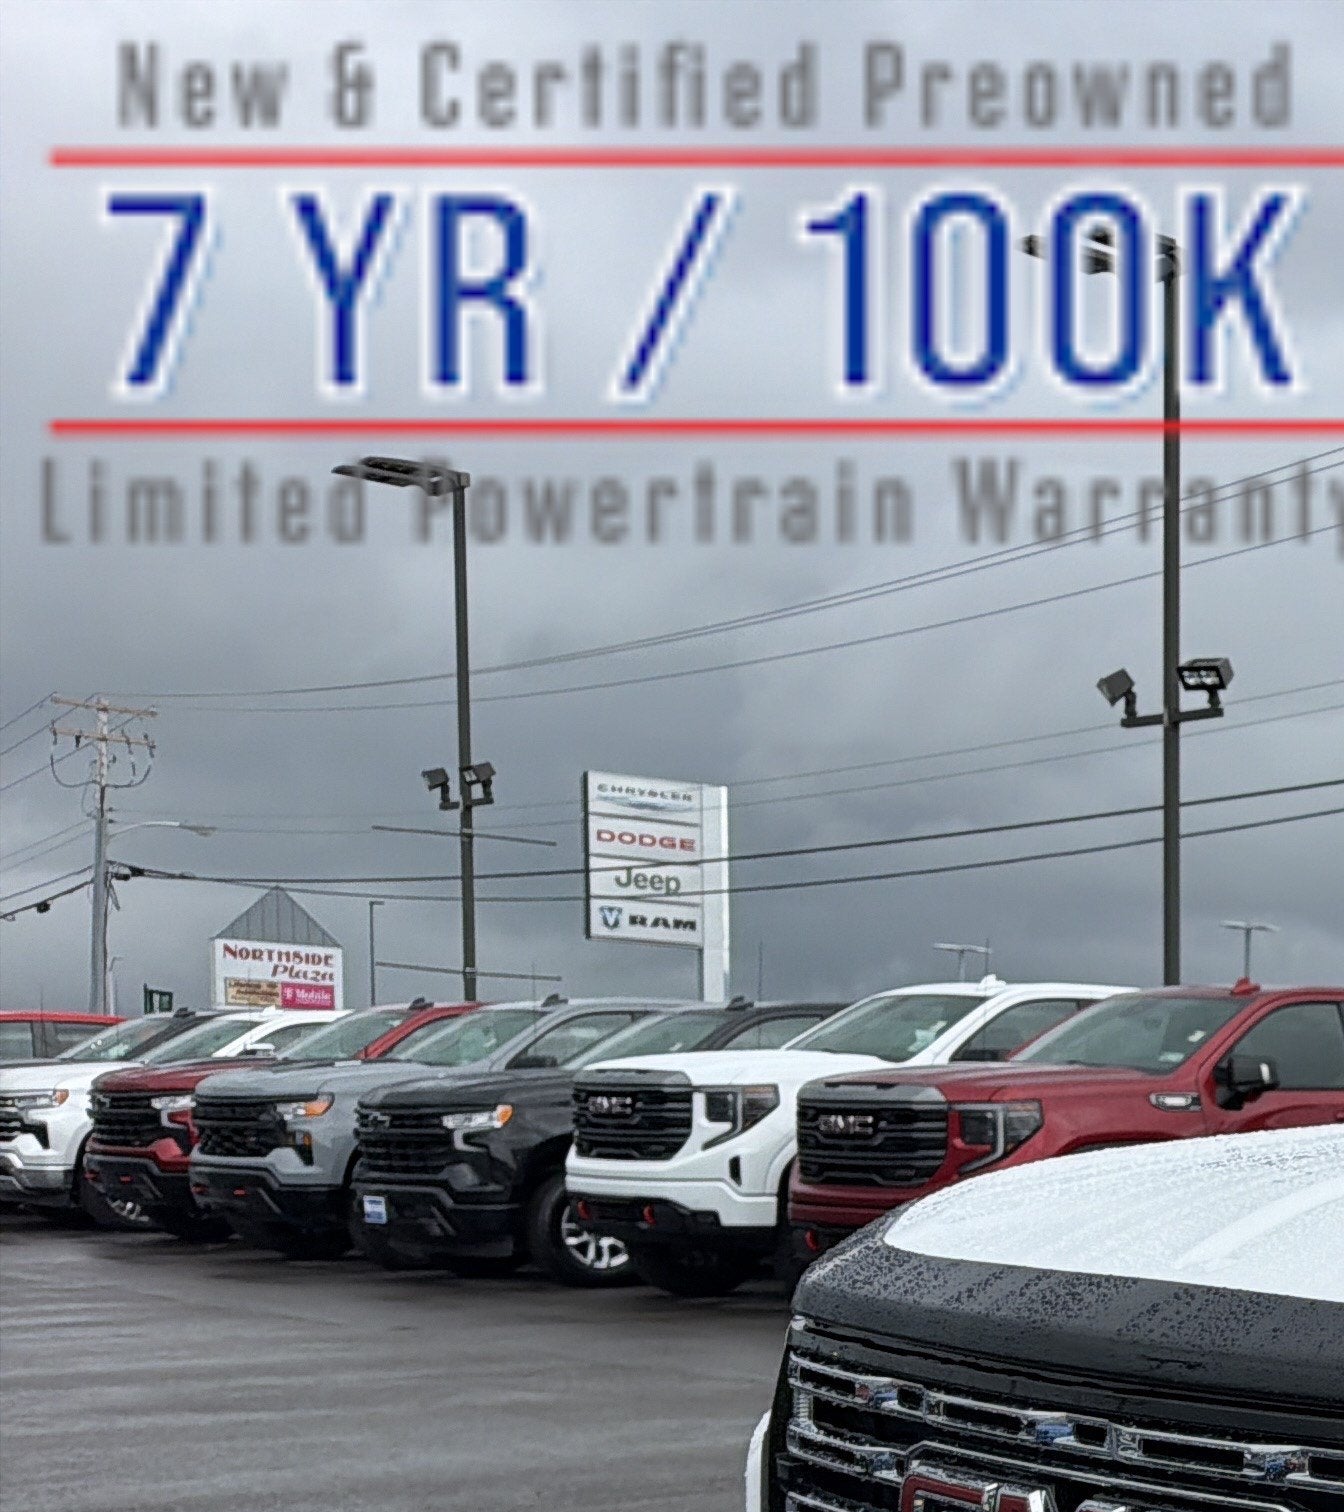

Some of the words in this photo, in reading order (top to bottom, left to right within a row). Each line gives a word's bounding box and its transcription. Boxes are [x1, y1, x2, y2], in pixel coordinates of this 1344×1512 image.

[597, 784, 692, 801] CHRYSLER
[597, 829, 696, 852] DODGE
[615, 868, 681, 895] Jeep
[629, 915, 696, 930] RAM
[271, 964, 335, 982] Plaza
